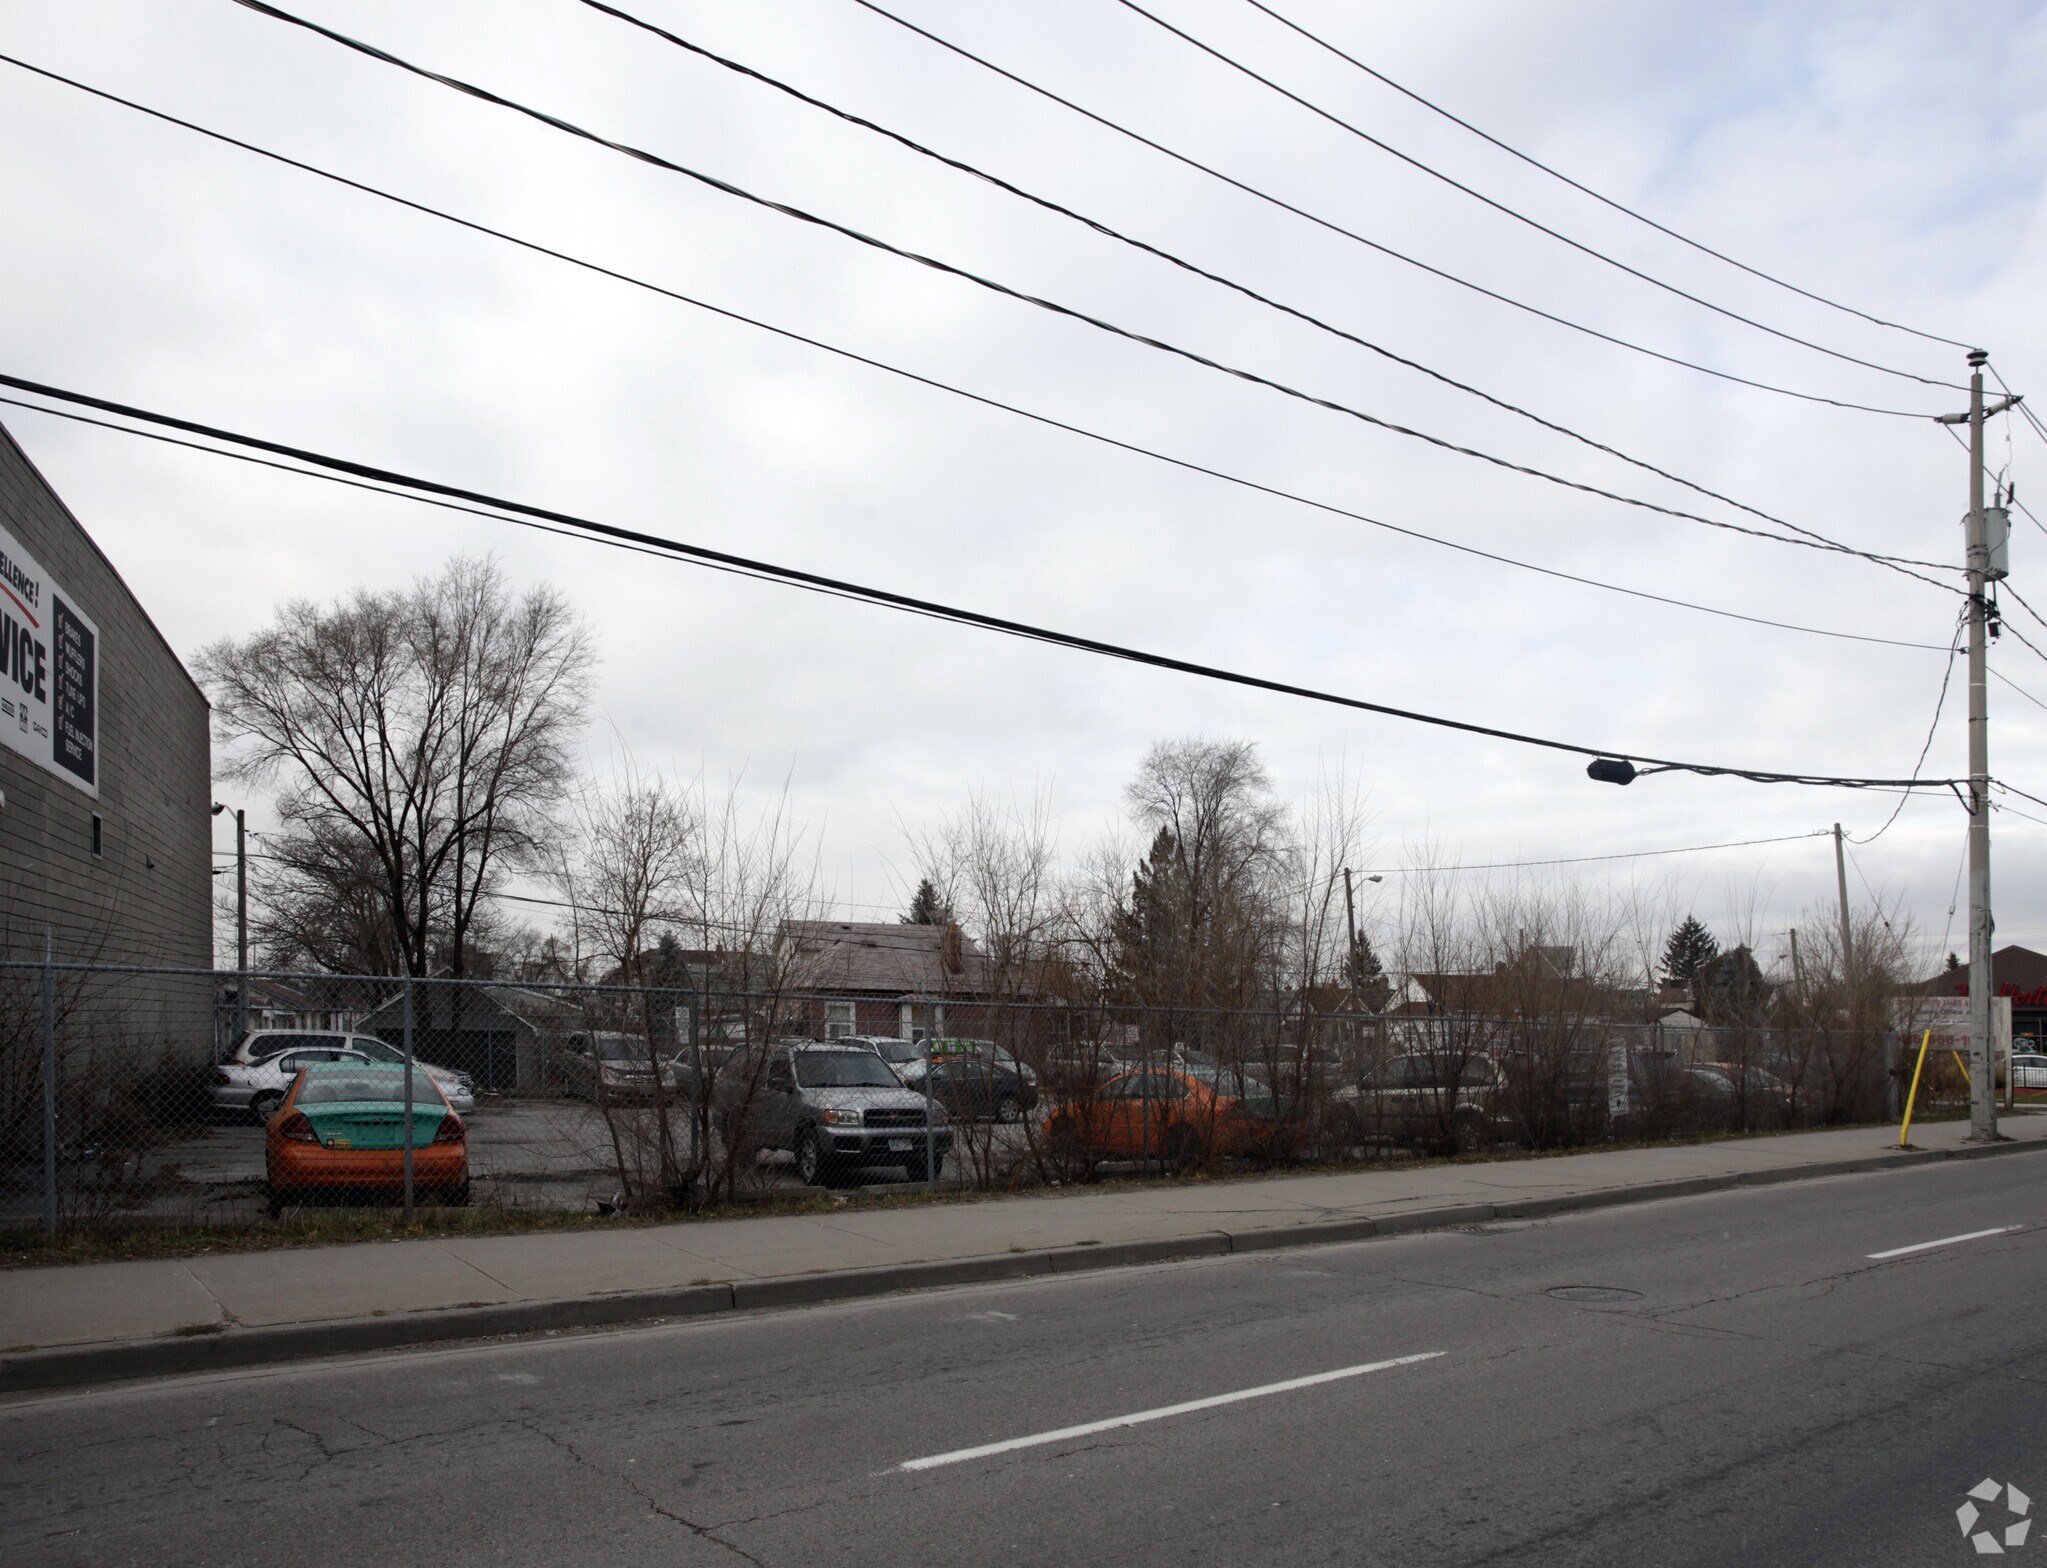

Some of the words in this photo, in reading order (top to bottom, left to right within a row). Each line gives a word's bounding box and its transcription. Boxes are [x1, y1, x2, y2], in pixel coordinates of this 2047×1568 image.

[65, 621, 81, 647] BRAKES
[65, 641, 86, 670] MUFFLERS
[65, 661, 83, 687] SHOCKS
[65, 721, 75, 739] FUEL
[74, 728, 94, 752] INJECTION
[65, 738, 83, 762] SERVICE
